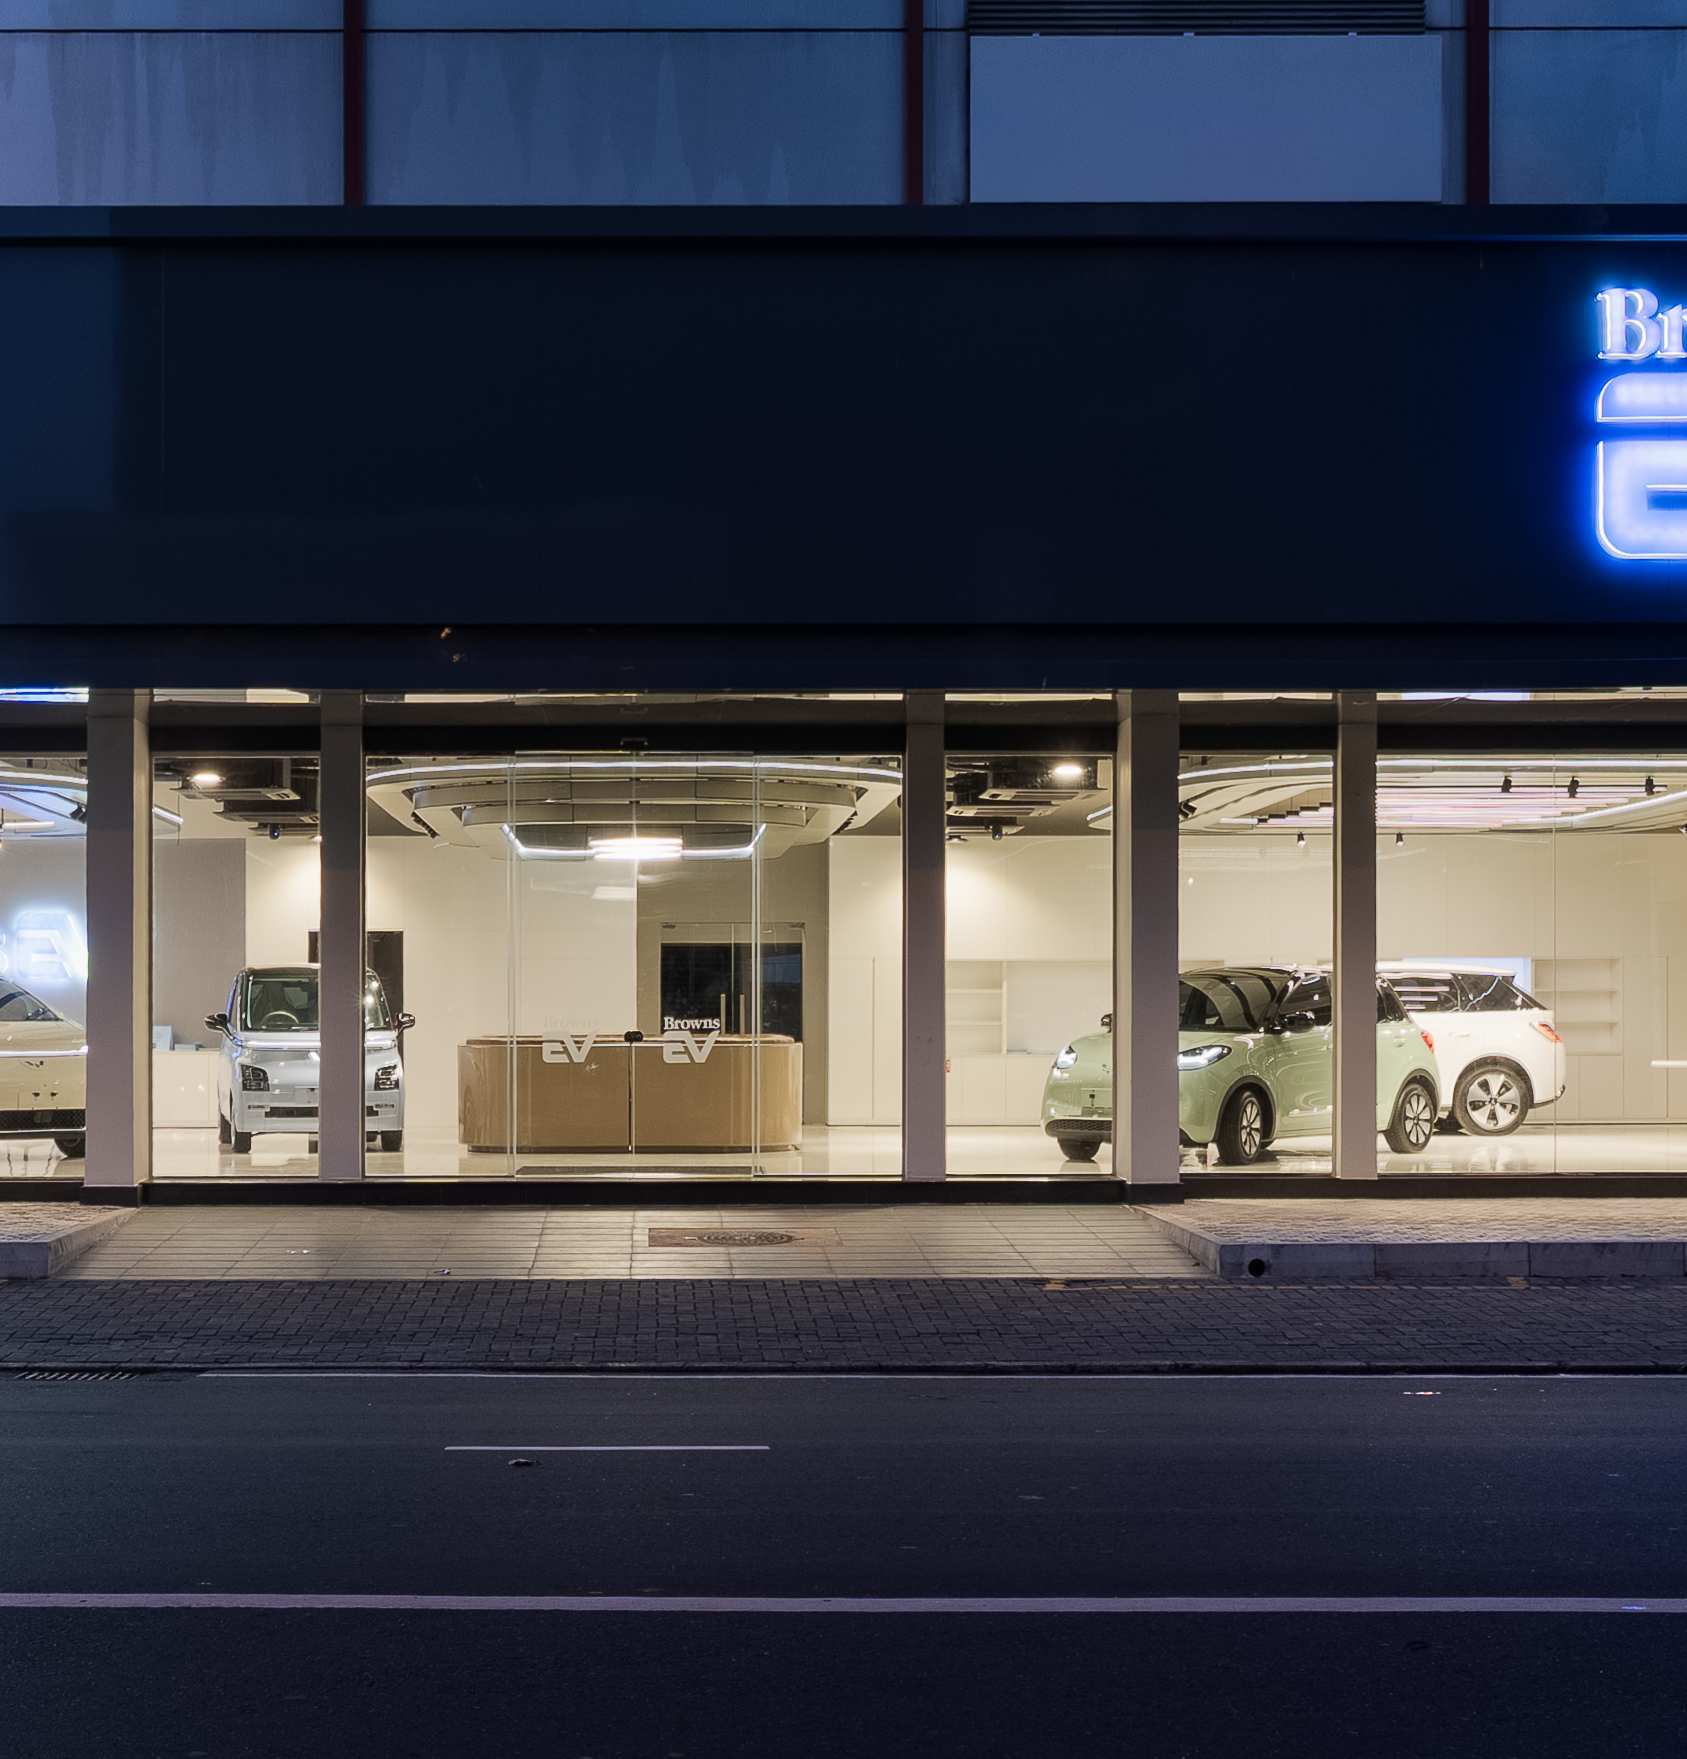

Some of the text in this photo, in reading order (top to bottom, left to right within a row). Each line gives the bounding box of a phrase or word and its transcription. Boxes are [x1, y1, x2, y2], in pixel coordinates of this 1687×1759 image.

[663, 1016, 721, 1030] Browns
[541, 1030, 598, 1064] EV
[662, 1030, 721, 1064] EV
